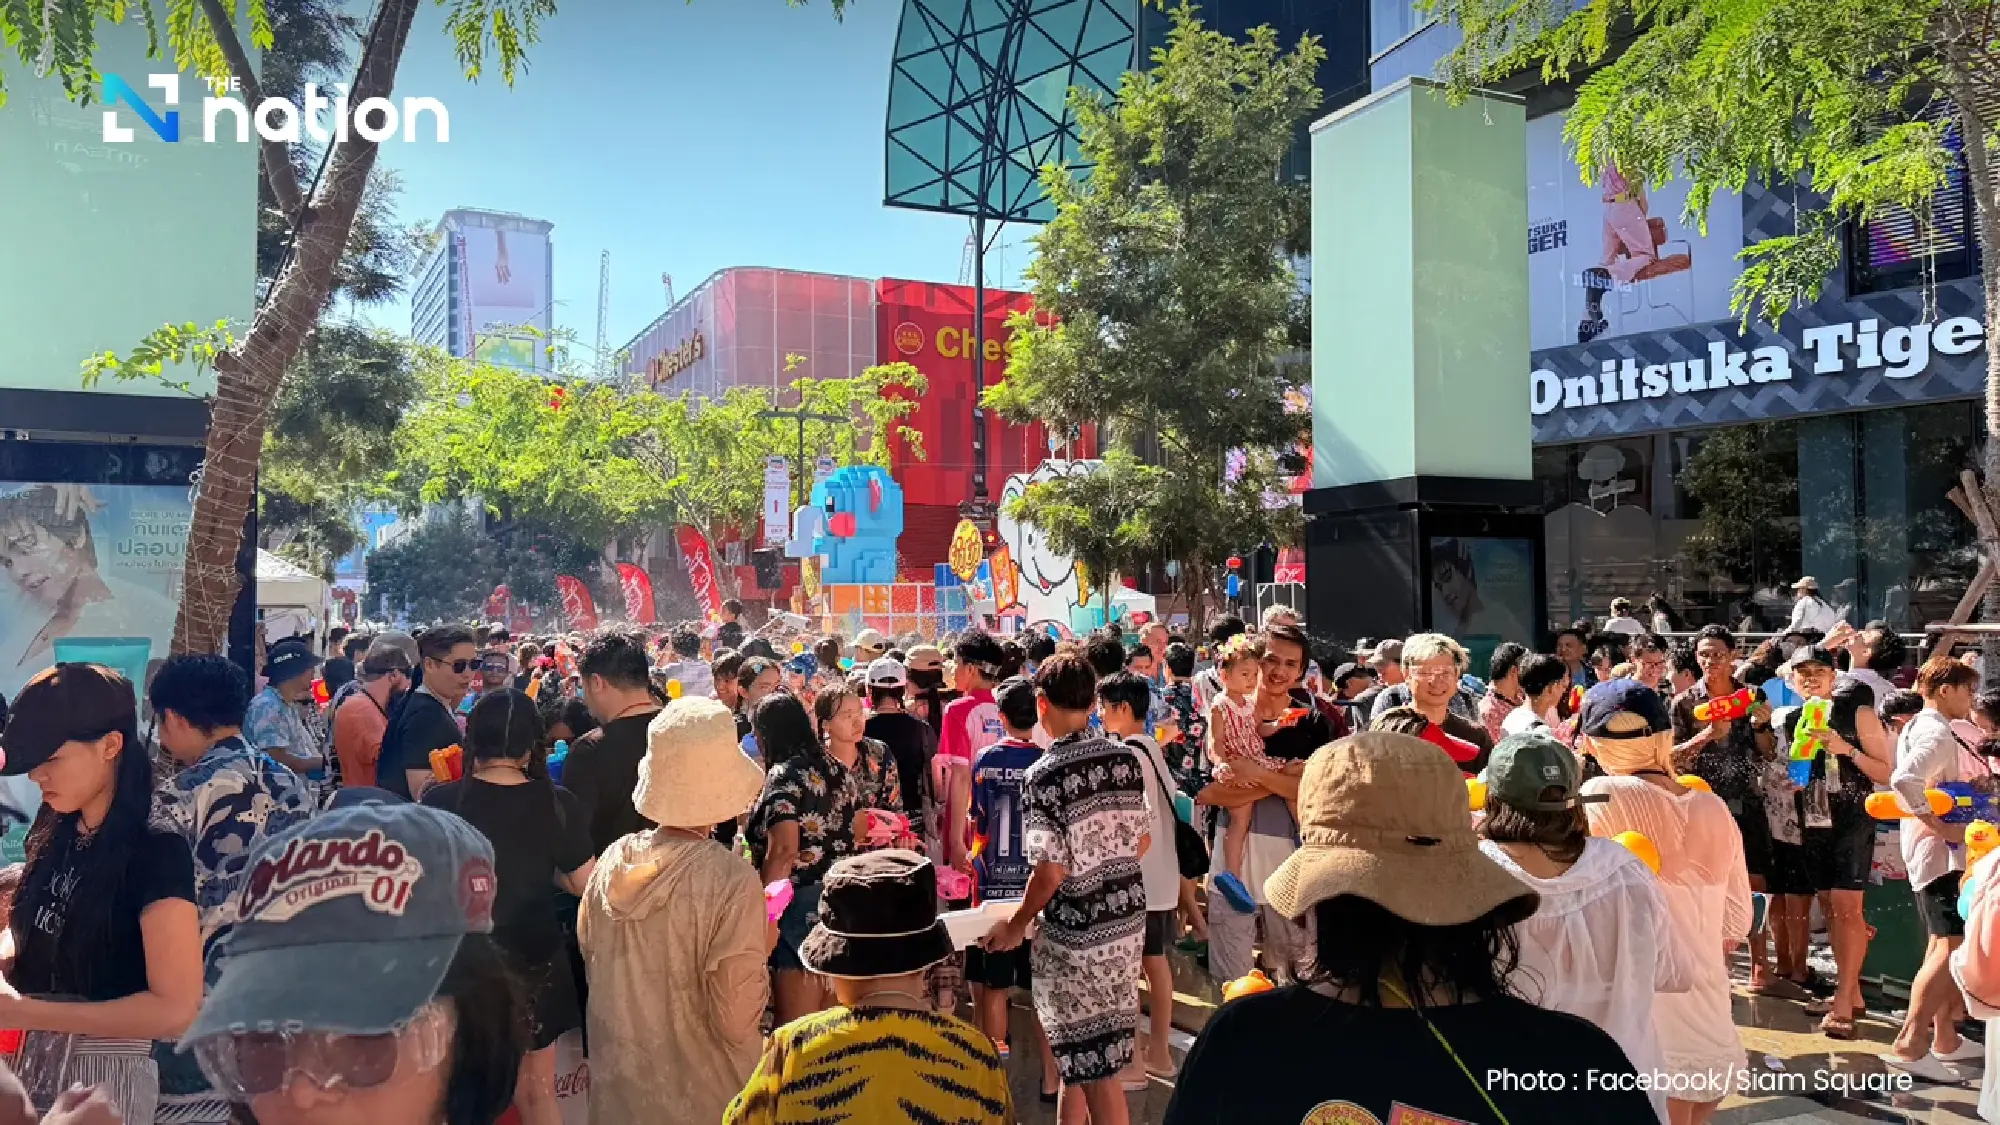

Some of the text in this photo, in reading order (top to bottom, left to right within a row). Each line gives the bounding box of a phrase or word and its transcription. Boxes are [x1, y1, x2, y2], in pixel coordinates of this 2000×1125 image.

[1531, 316, 1989, 415] Onitsuka Tige
[285, 873, 358, 906] Original
[371, 875, 411, 910] 01
